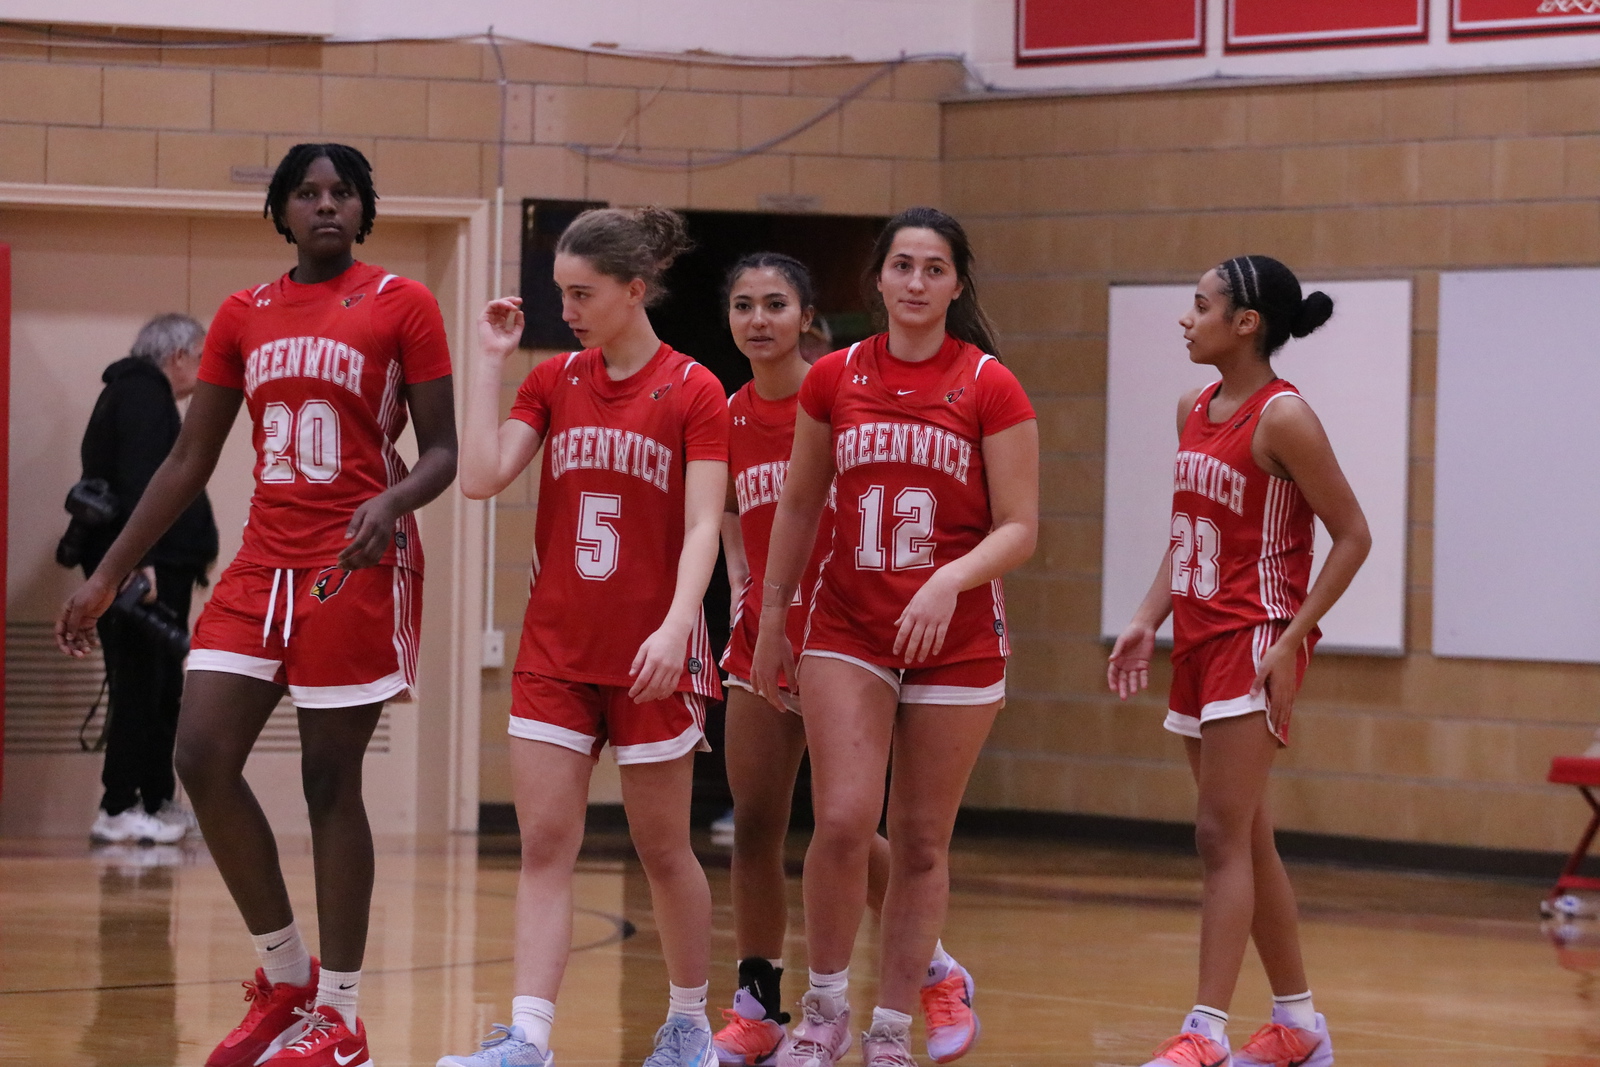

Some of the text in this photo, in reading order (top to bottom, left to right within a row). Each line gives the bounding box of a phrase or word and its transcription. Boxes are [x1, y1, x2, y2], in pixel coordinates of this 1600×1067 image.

[261, 400, 341, 484] 20
[552, 426, 672, 493] GREENWICH
[836, 422, 972, 486] GREENWICH
[574, 491, 622, 581] 5
[855, 485, 937, 571] 12
[1169, 512, 1221, 600] 23
